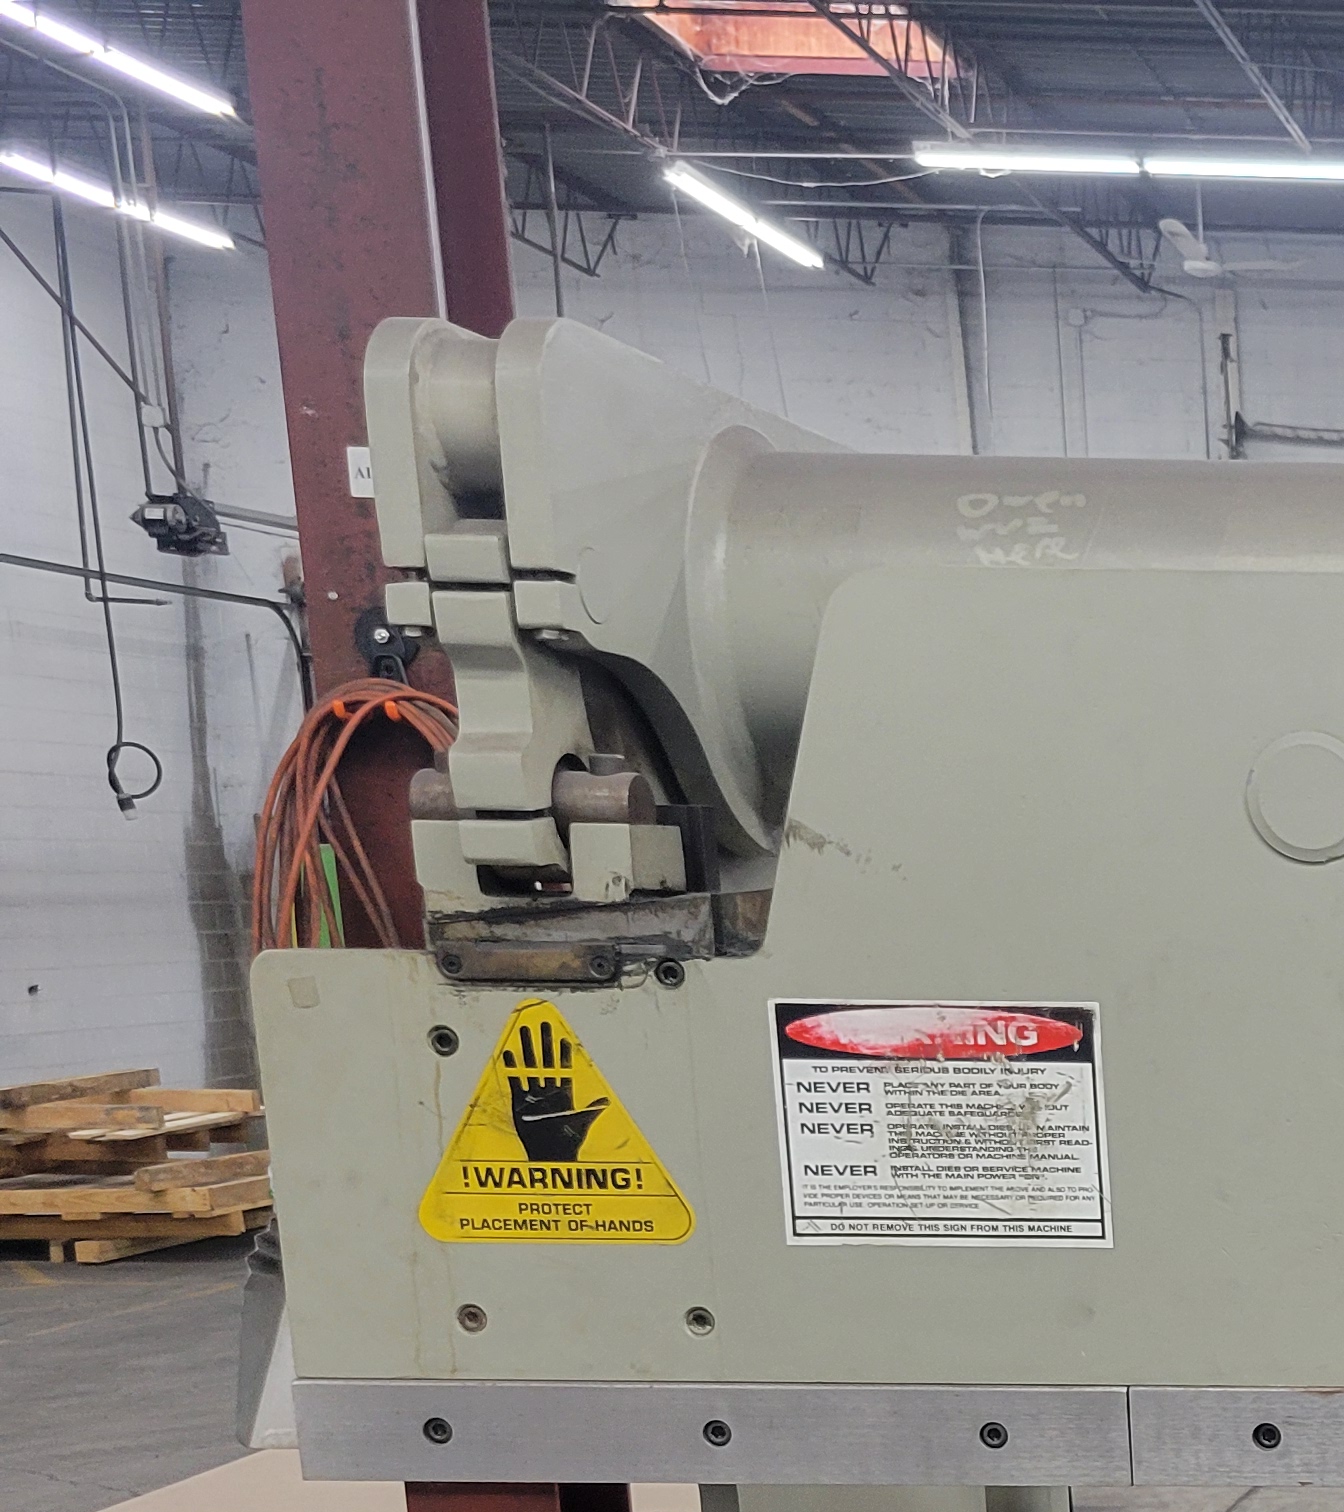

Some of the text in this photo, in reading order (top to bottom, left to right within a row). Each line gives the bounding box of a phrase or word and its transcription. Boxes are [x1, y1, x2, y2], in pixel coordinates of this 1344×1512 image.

[811, 1066, 828, 1074] TO
[953, 1067, 997, 1075] BODILY
[1000, 1067, 1047, 1075] INJURY
[796, 1081, 870, 1093] NEVER
[798, 1102, 873, 1114] NEVER
[800, 1123, 874, 1135] NEVER
[804, 1164, 877, 1177] NEVER
[462, 1166, 643, 1190] !WARNING!
[518, 1202, 592, 1216] PROTECT
[460, 1218, 654, 1232] PLACEMENT OF HANDS
[830, 1223, 846, 1231] DO
[849, 1223, 869, 1231] NOT
[872, 1224, 914, 1232] REMOVE
[918, 1224, 940, 1232] THIS
[943, 1224, 967, 1232] SIGN
[970, 1224, 999, 1232] FROM
[1028, 1225, 1073, 1233] MACHINE
